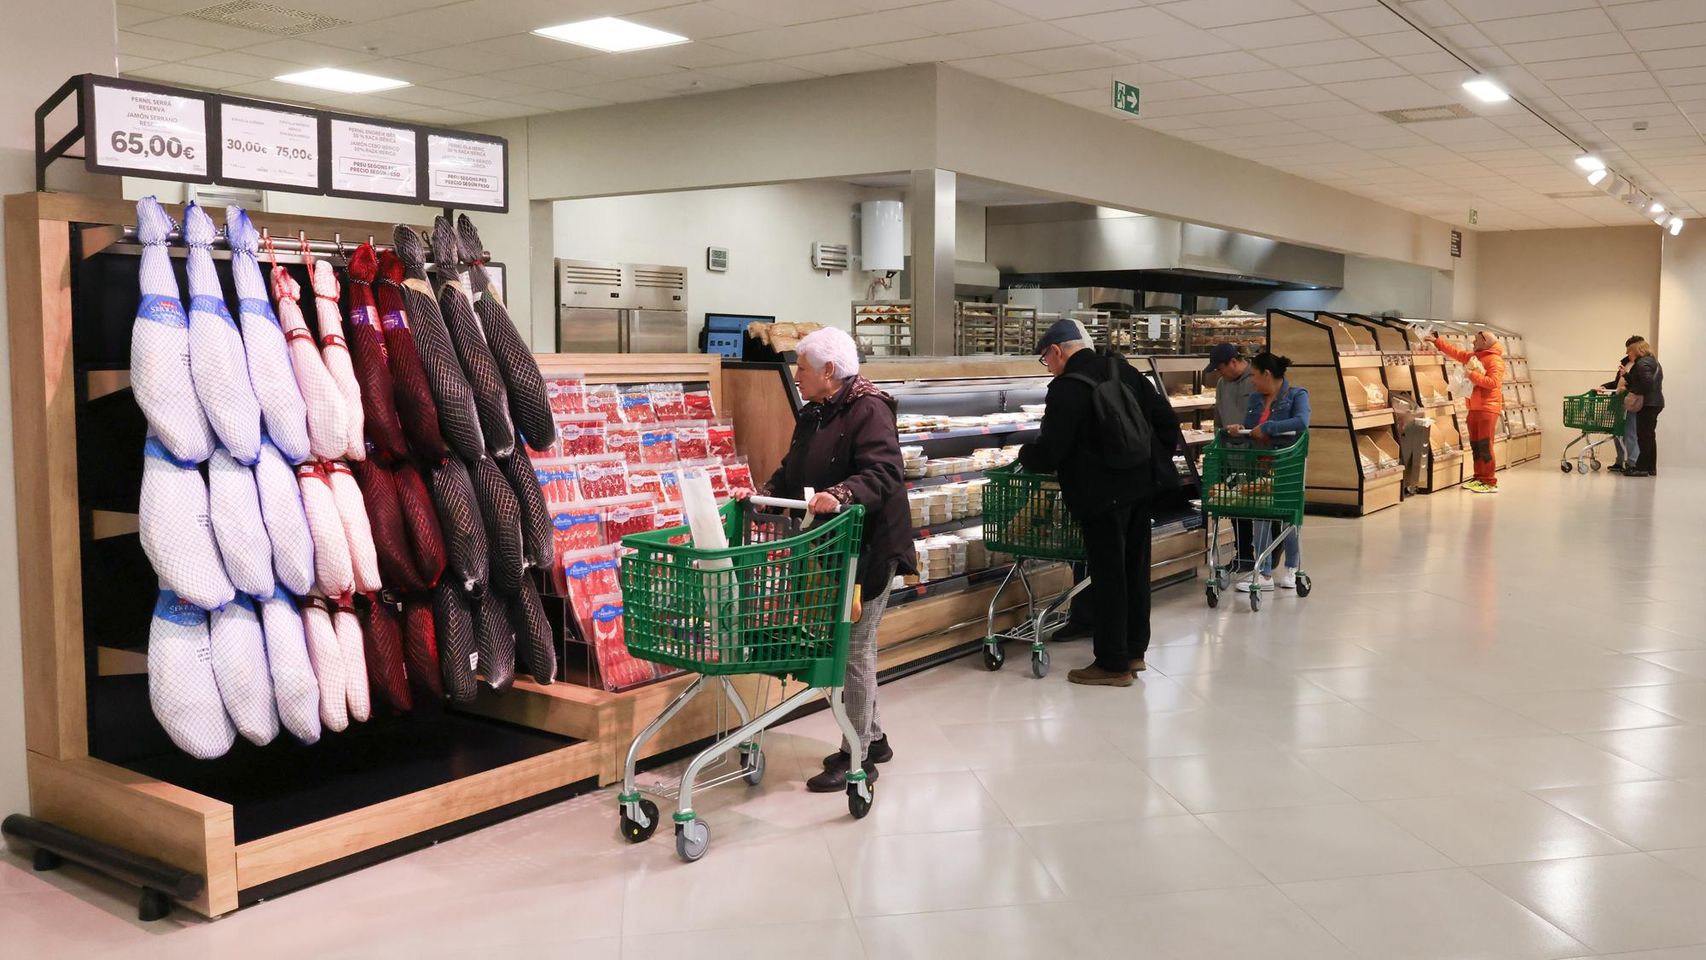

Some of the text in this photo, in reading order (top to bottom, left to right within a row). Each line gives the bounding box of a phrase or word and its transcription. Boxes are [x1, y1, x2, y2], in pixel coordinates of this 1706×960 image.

[131, 96, 151, 104] PERNIL
[138, 105, 166, 113] RESERVA
[127, 112, 149, 120] JAMÓN
[111, 130, 195, 160] 65,00€
[227, 138, 268, 154] 30,00€
[276, 145, 313, 161] 75,00€
[350, 166, 369, 174] PRECIO
